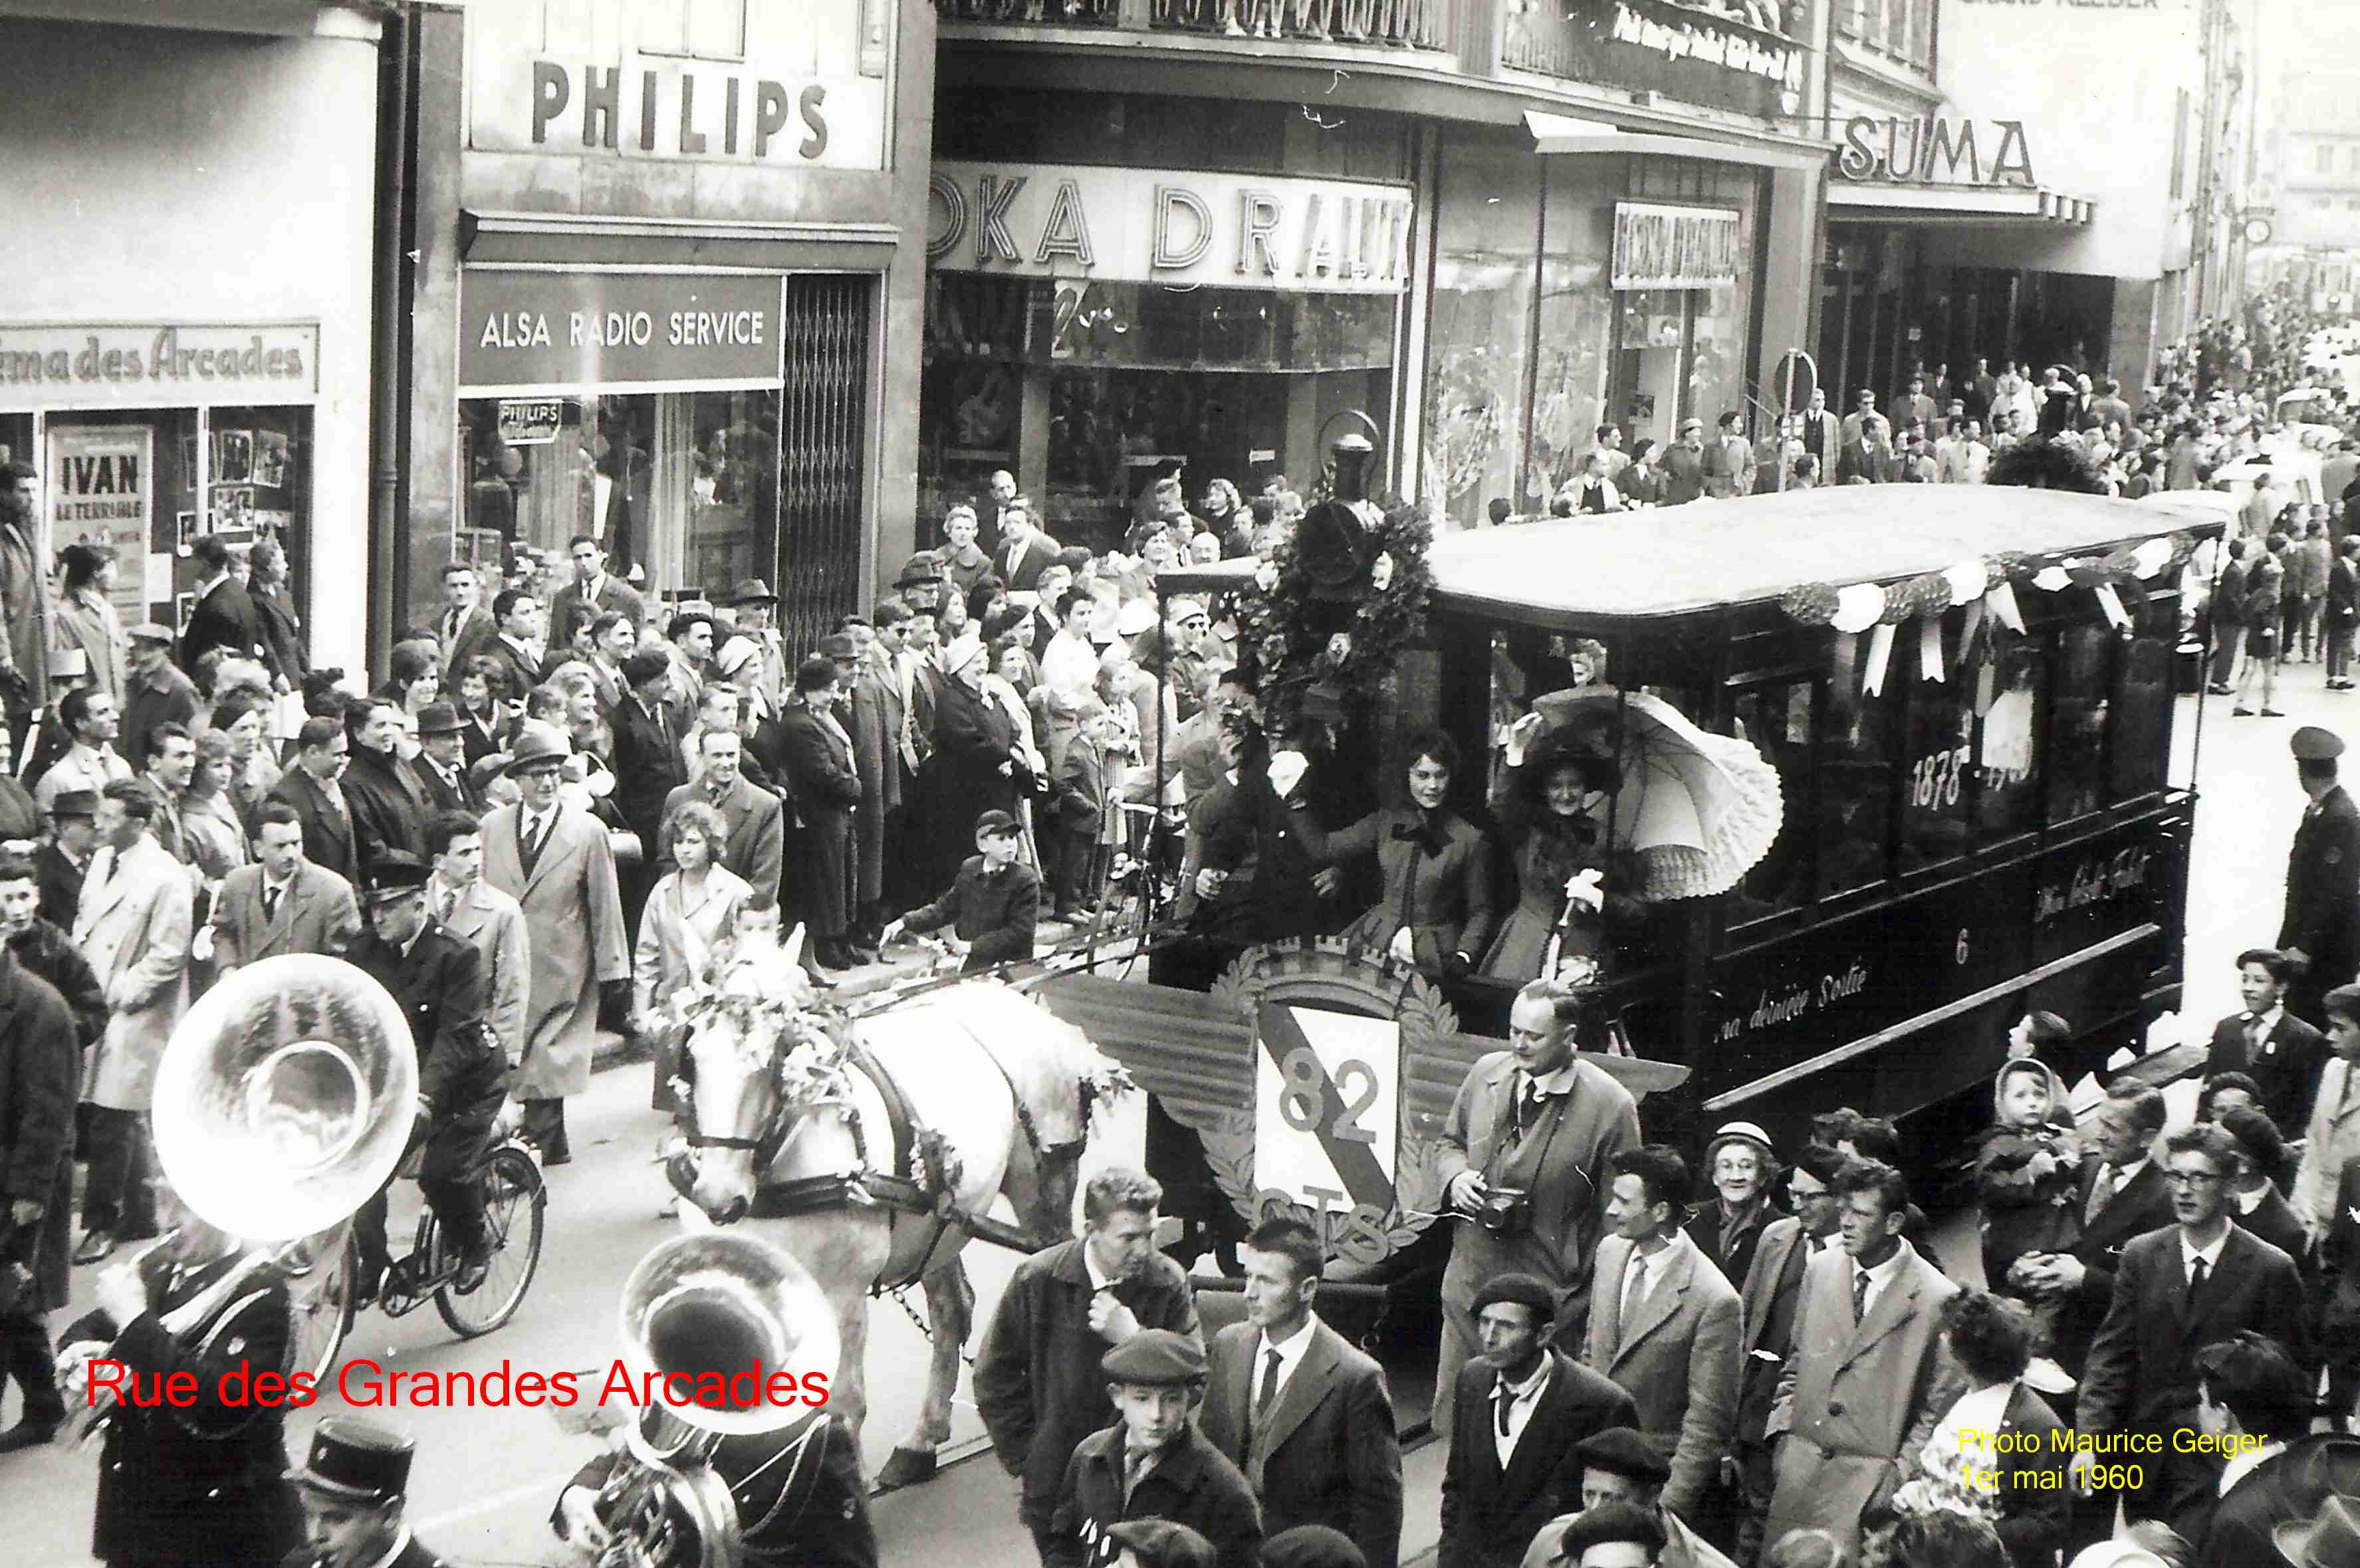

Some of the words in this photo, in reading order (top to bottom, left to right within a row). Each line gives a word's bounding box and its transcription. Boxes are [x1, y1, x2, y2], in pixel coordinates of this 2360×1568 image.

[532, 60, 828, 160] PHILIPS
[1840, 116, 2035, 183] SUMA
[74, 335, 143, 383] des
[148, 326, 303, 382] Arcades
[480, 311, 552, 348] ALSA
[570, 310, 652, 347] RADIO
[668, 310, 765, 346] SERVICE
[501, 405, 558, 422] PHILIPS
[62, 455, 138, 495] IVAN
[1912, 744, 1962, 812] 1878
[1956, 927, 1969, 965] 6
[1279, 1046, 1379, 1145] 82
